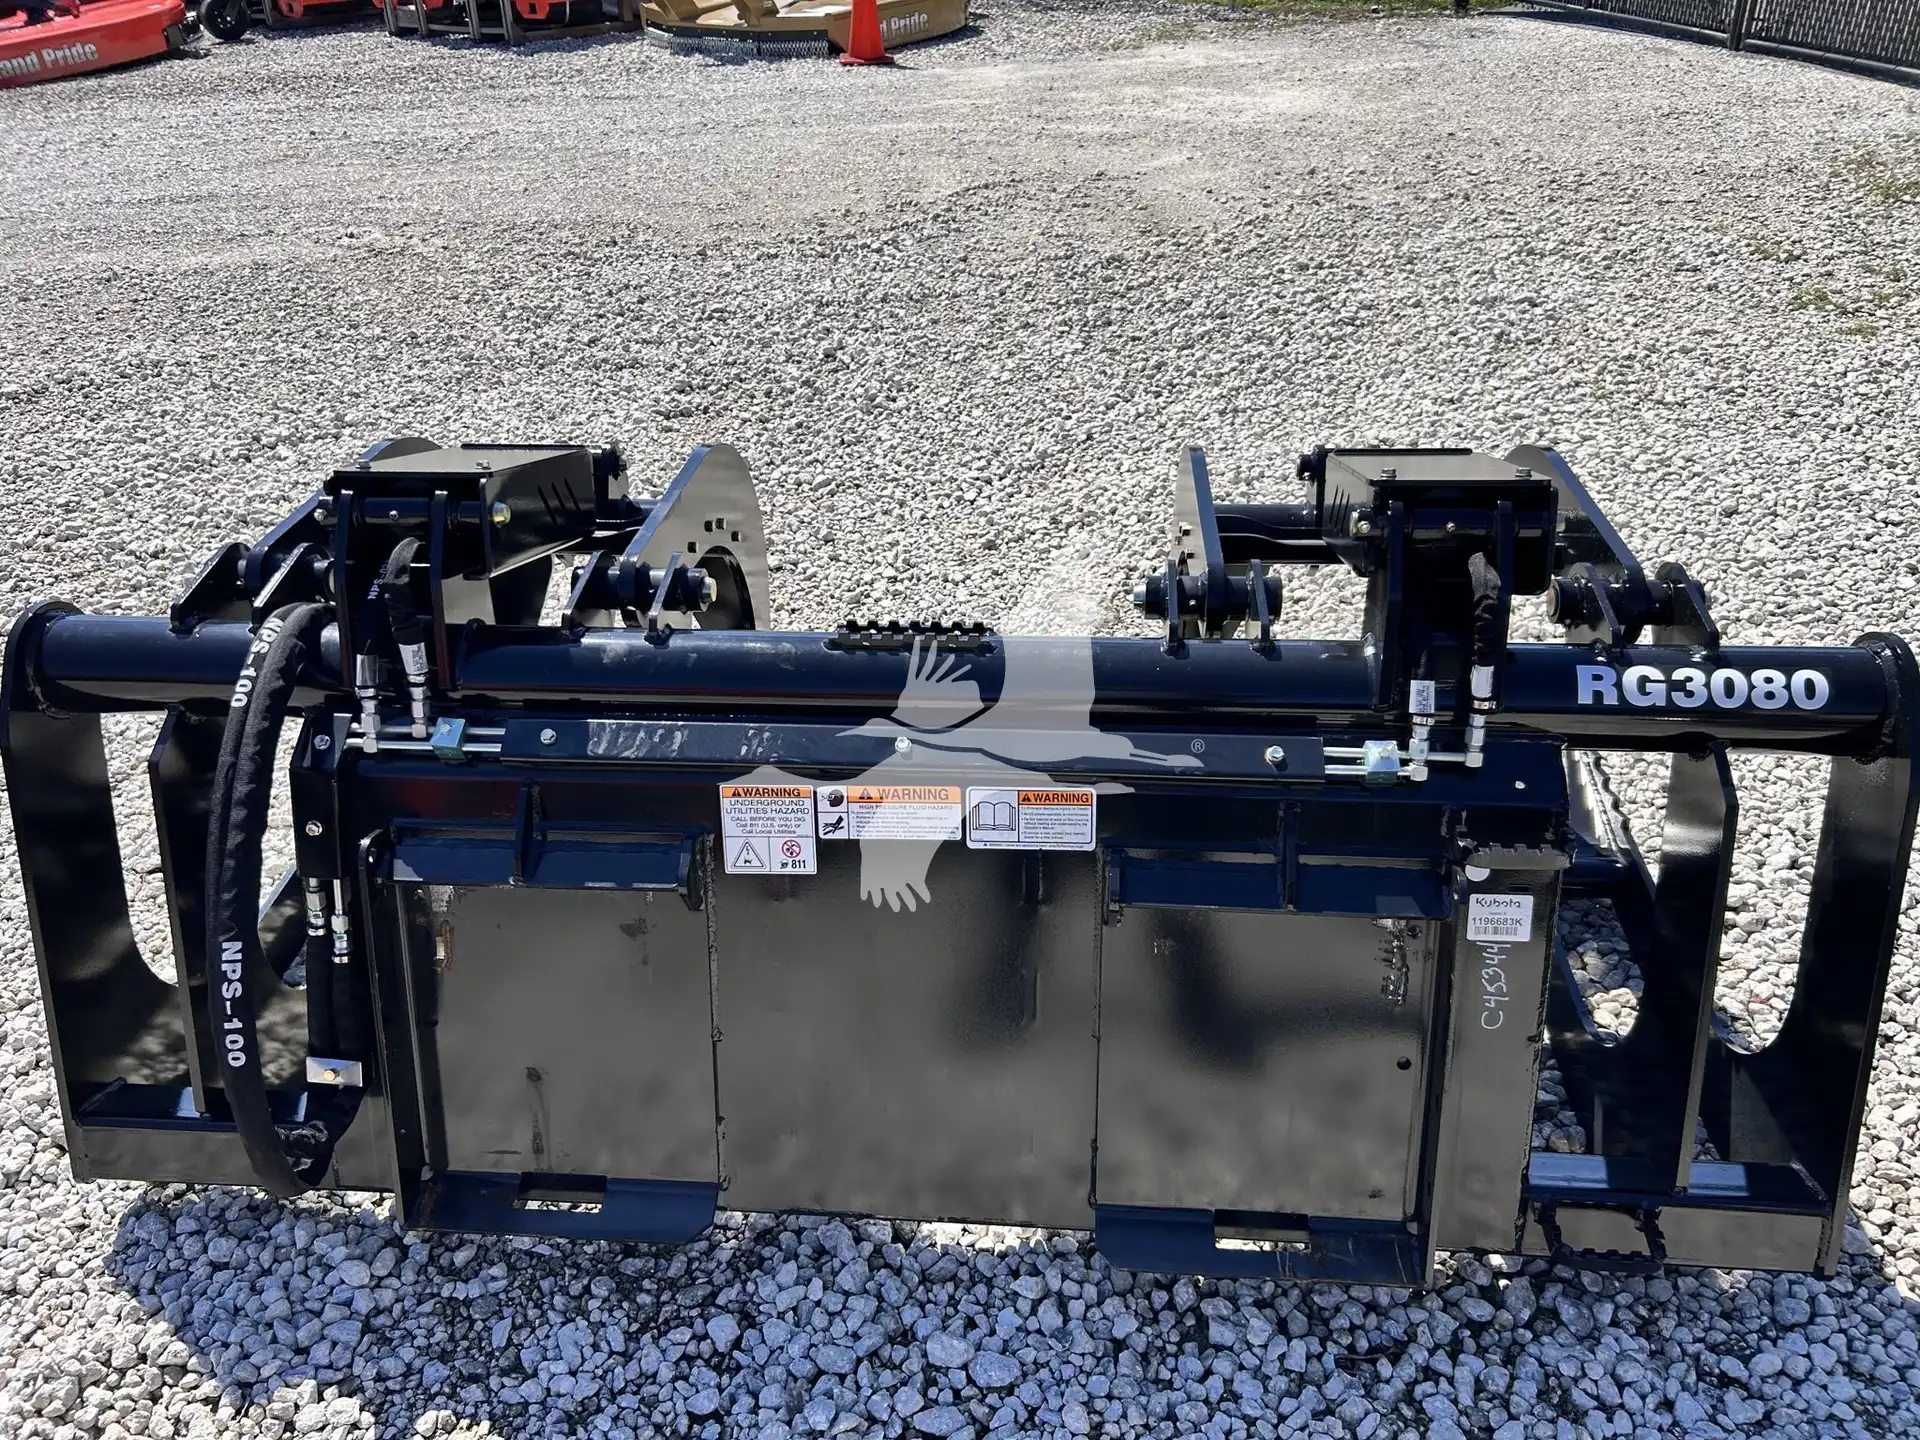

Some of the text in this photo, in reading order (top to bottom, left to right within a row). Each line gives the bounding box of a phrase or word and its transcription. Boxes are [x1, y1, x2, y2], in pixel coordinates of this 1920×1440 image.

[891, 12, 929, 39] Pride
[0, 42, 99, 78] and Pride
[230, 617, 285, 707] NPS-100
[1576, 665, 1829, 710] RG3080
[743, 788, 801, 797] WARNING
[877, 788, 949, 800] WARNING
[1032, 793, 1089, 803] WARNING
[726, 807, 810, 815] UTILITIES HAZARD
[791, 860, 806, 869] 811
[1476, 897, 1521, 908] Kubota
[1472, 917, 1524, 926] 1196683K
[221, 941, 246, 1067] NPS-100
